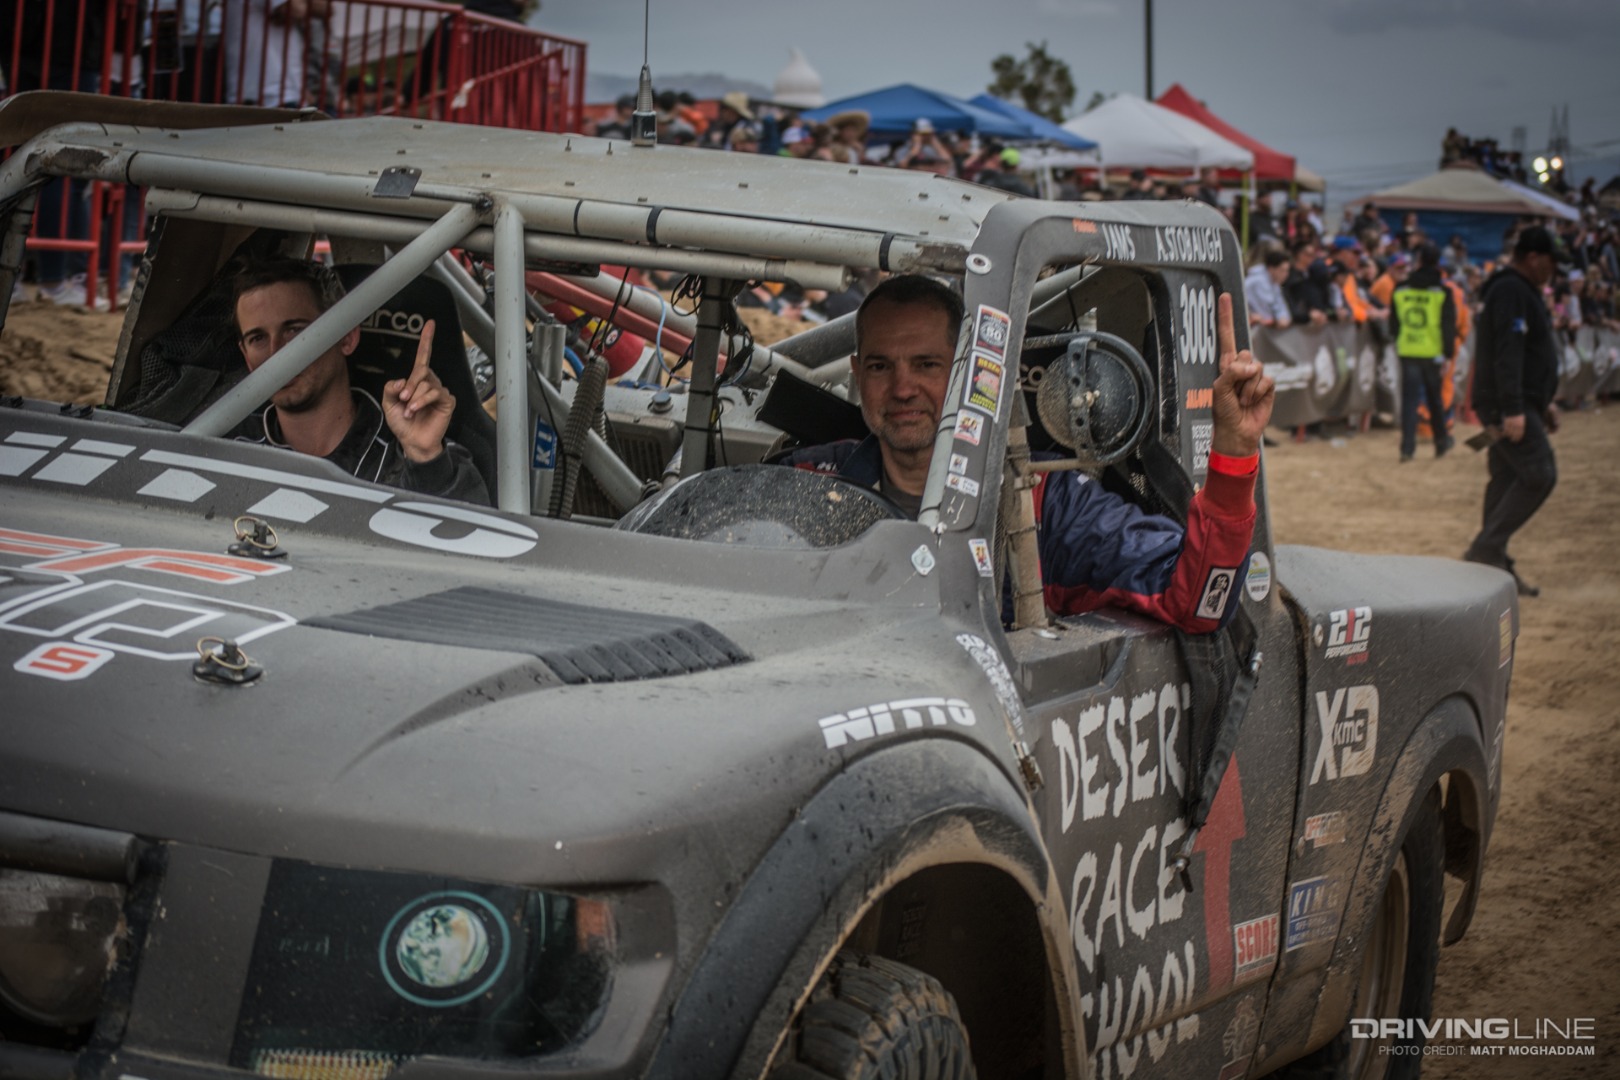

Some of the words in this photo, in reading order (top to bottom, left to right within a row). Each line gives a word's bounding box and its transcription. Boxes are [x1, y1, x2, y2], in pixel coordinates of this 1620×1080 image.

[1180, 283, 1216, 365] 3003
[1070, 818, 1187, 974] RACE
[1237, 917, 1277, 965] SCORE
